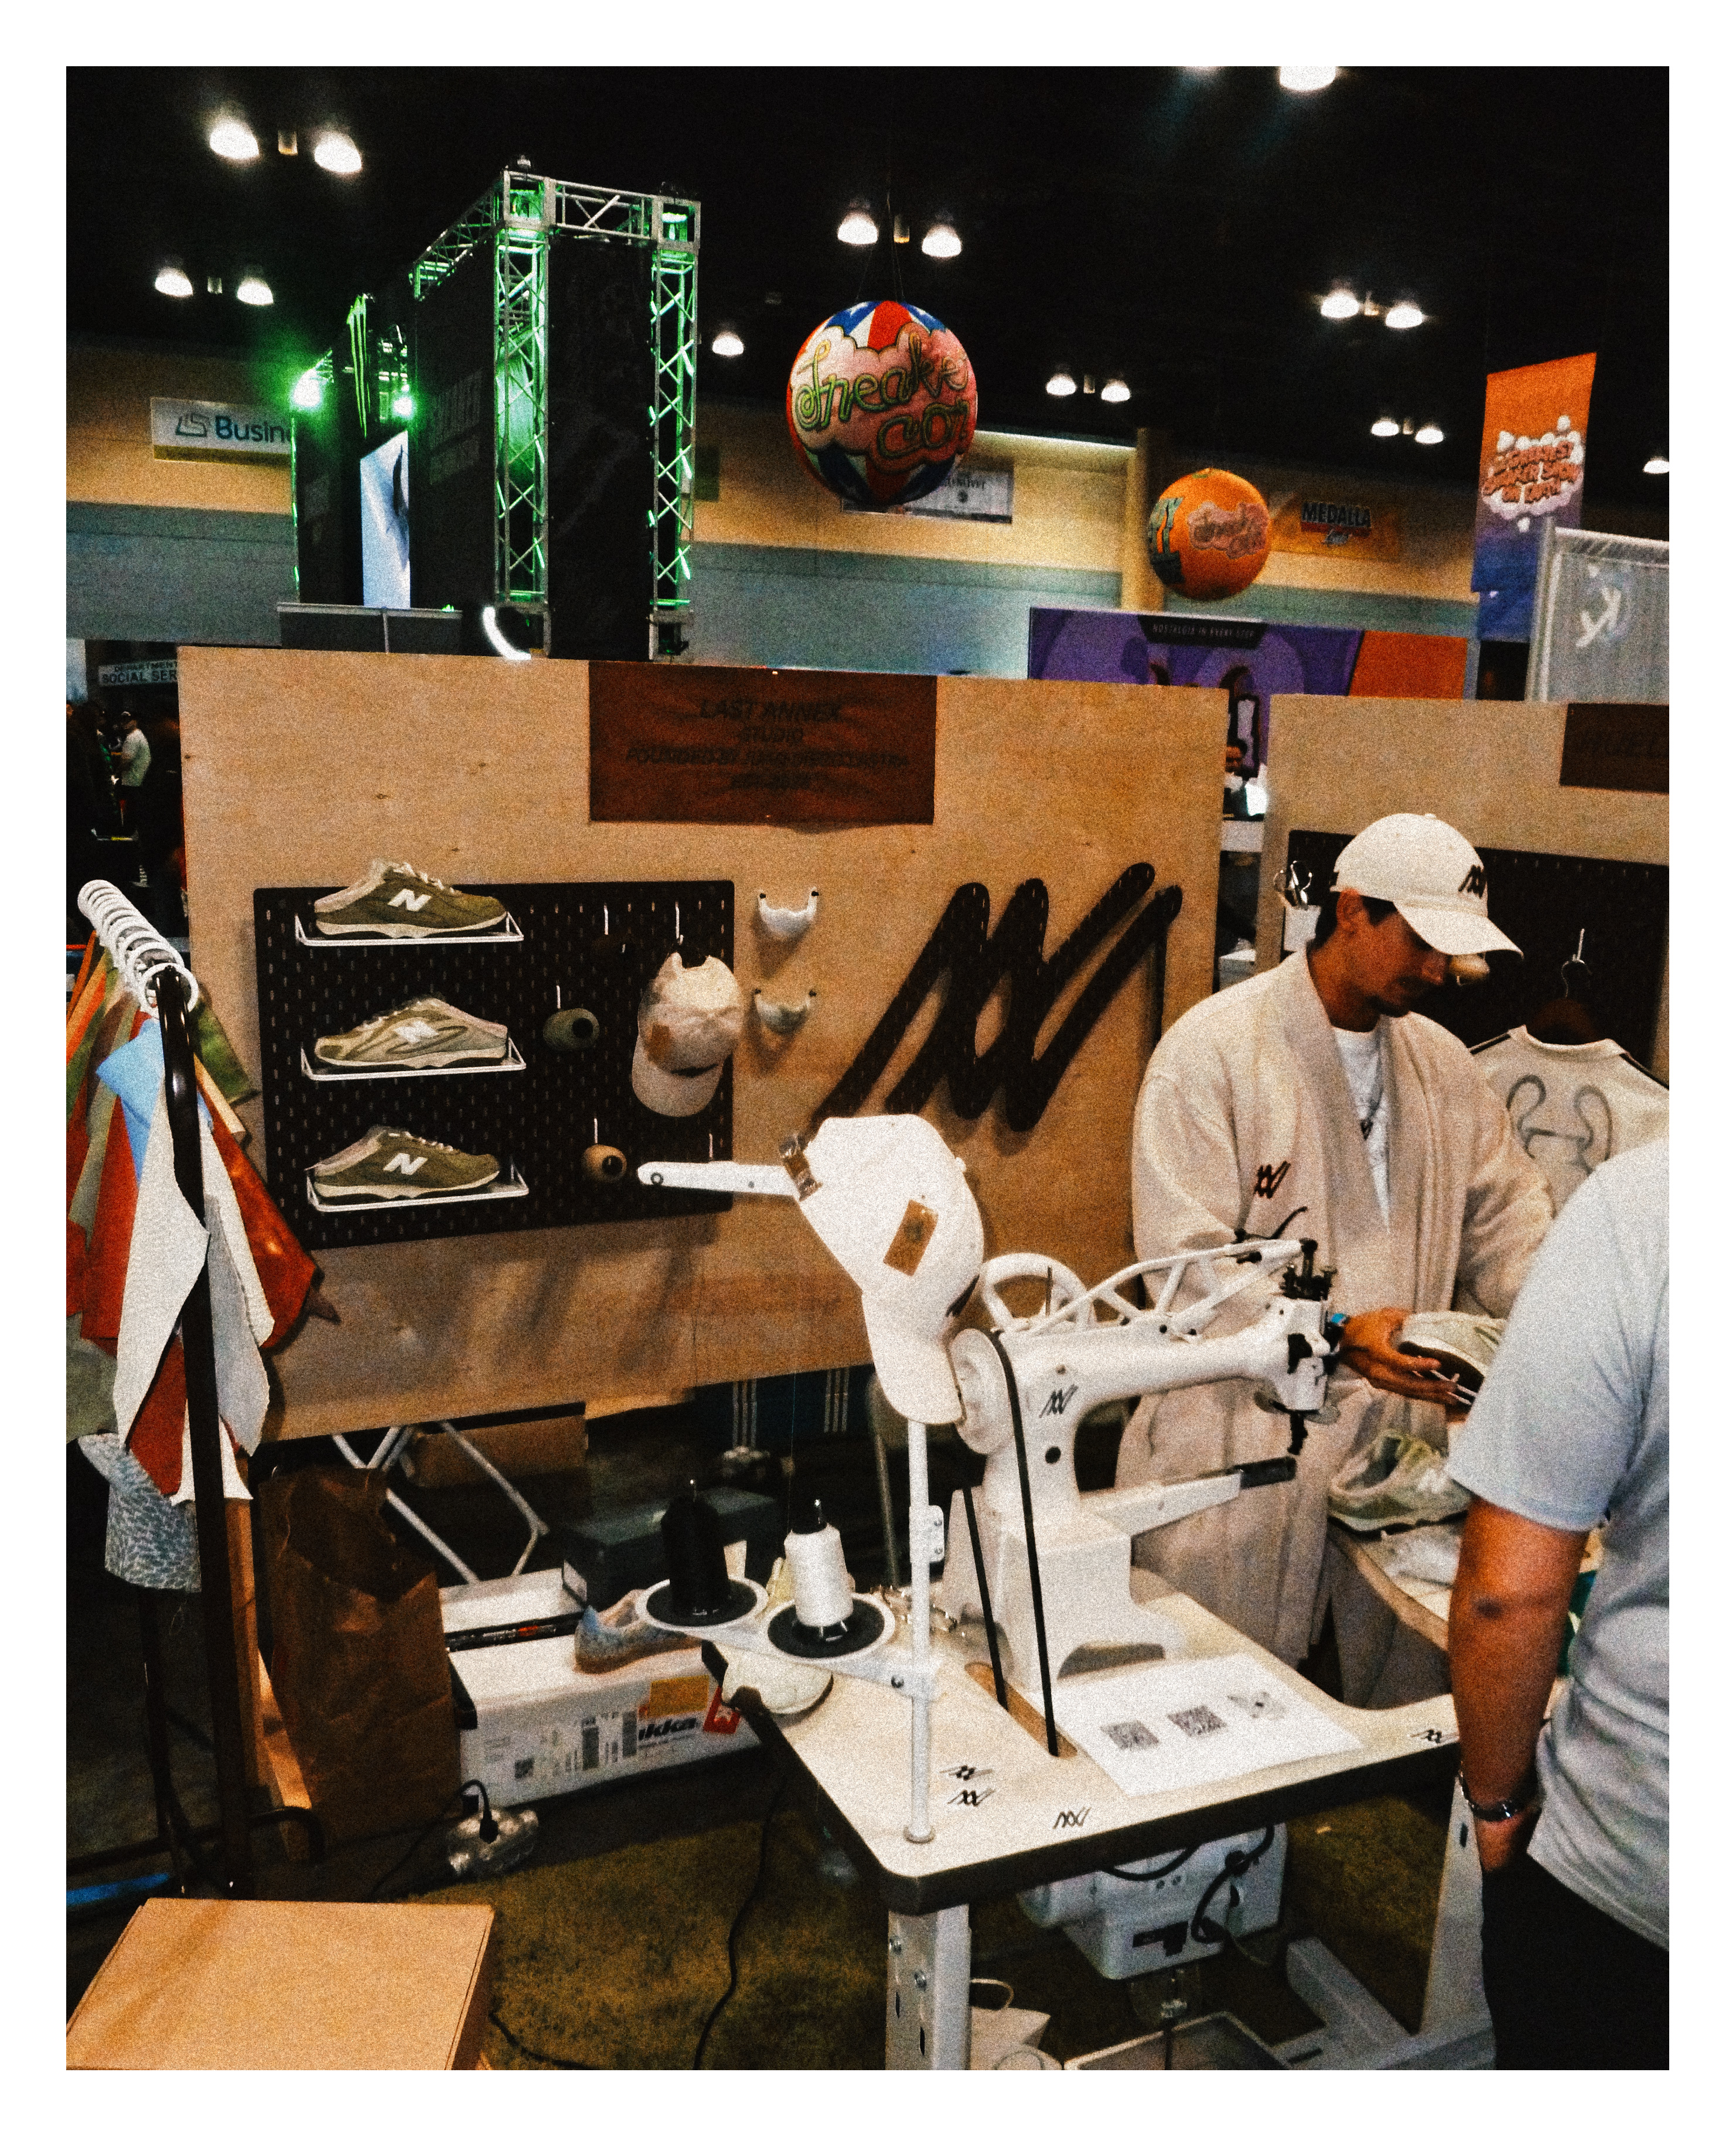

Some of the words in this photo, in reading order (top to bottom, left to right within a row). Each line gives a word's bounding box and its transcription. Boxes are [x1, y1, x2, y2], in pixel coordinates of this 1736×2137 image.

[1301, 501, 1372, 528] MEDALLA
[102, 671, 147, 684] SOCIAL
[700, 699, 756, 719] LAST
[737, 726, 804, 743] STUDIO
